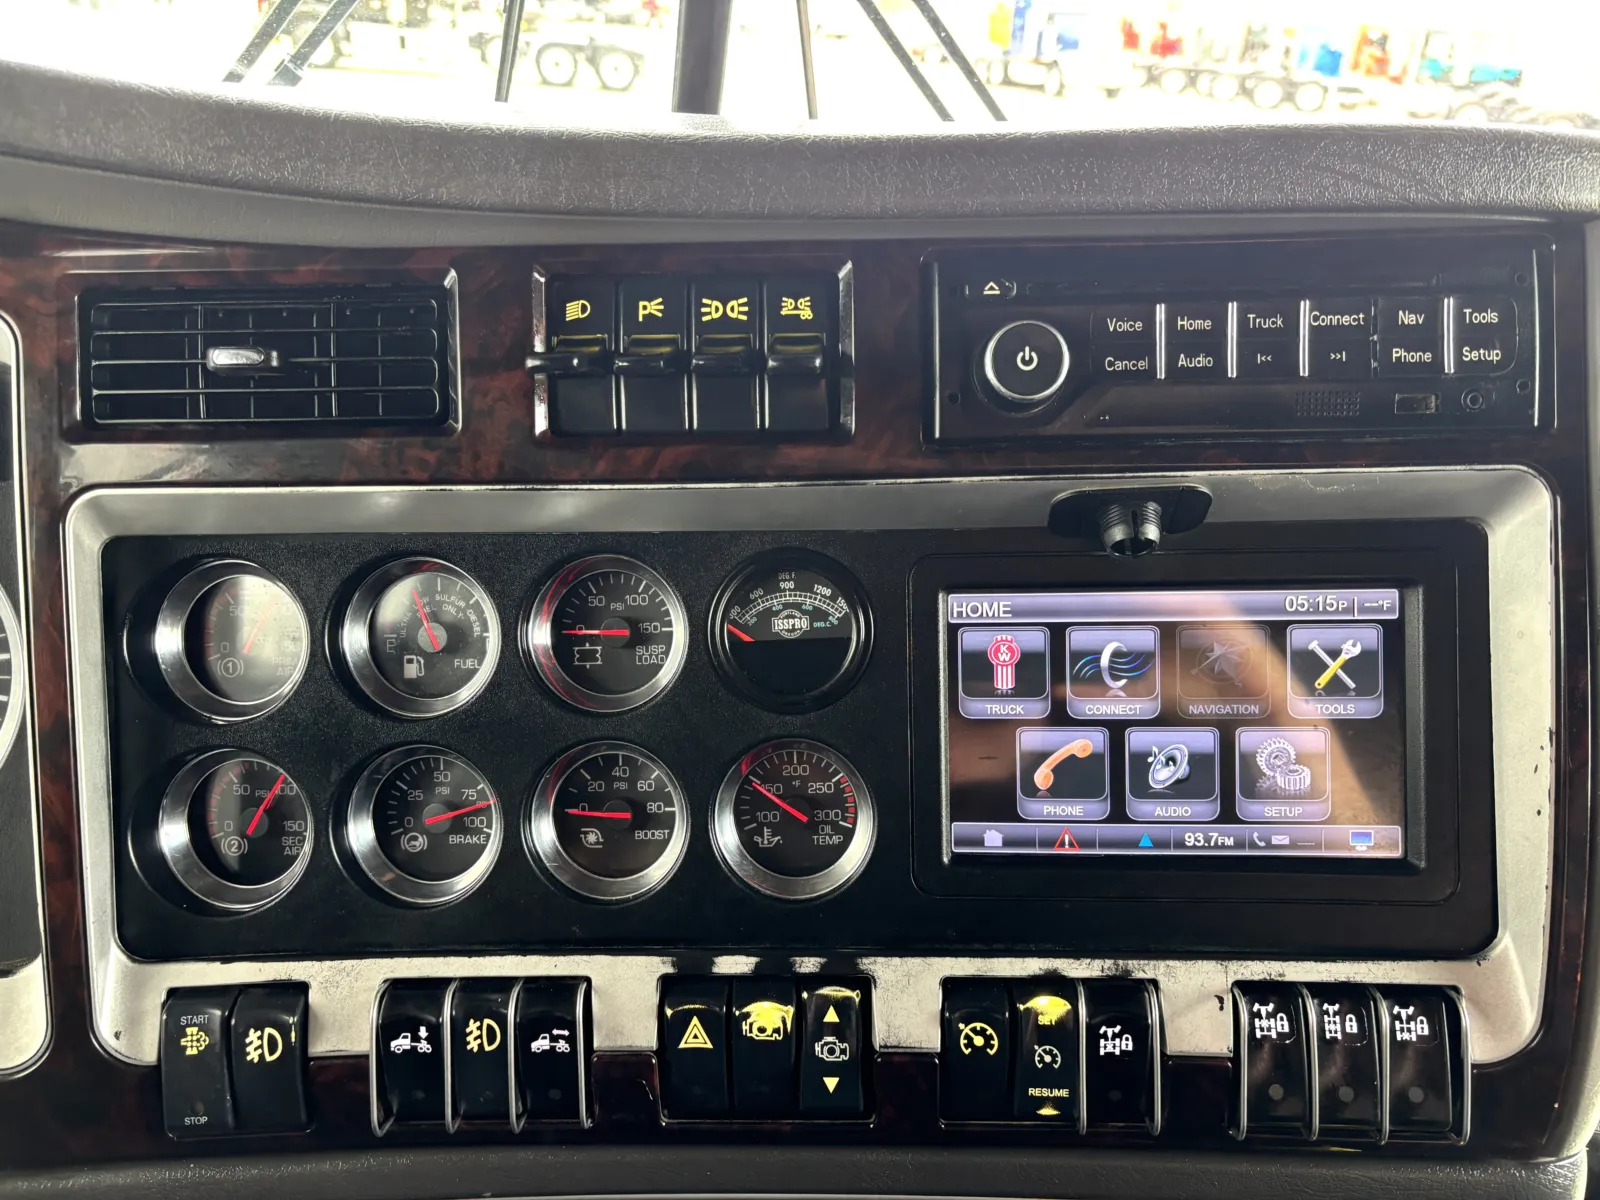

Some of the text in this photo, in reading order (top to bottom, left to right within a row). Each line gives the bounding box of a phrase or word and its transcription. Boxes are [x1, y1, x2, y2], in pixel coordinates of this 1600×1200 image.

[1247, 314, 1284, 329] Truck
[1310, 311, 1365, 327] Connect
[1398, 310, 1425, 325] Nav
[1463, 309, 1499, 324] Tools
[1106, 318, 1143, 332] Voice
[1177, 316, 1212, 331] Home
[1177, 353, 1213, 368] Audio
[1391, 348, 1432, 364] Phone
[1461, 347, 1502, 364] Setup
[1105, 356, 1149, 371] Cancel
[779, 580, 795, 590] 900
[813, 584, 832, 597] 1200
[749, 587, 764, 600] 600
[435, 593, 466, 609] SULFUR
[588, 595, 606, 607] 50
[624, 594, 649, 606] 100
[416, 604, 437, 619] FEL
[610, 603, 625, 611] PSI
[952, 601, 1013, 618] HOME
[399, 611, 413, 638] ULTRA
[466, 609, 481, 638] DIESEL
[638, 622, 661, 634] 150
[774, 618, 808, 630] ISSPRO
[220, 641, 230, 653] 0
[635, 645, 666, 655] SUSP
[454, 658, 481, 669] FUEL
[635, 655, 667, 665] LOAD
[985, 704, 1025, 715] TRUCK
[1084, 703, 1142, 716] CONNECT
[1188, 703, 1260, 715] NAVIGATION
[1315, 703, 1356, 715] TOOLS
[611, 766, 630, 778] 40
[782, 764, 810, 776] 200
[433, 771, 451, 782] 50
[233, 784, 250, 795] 50
[275, 784, 297, 795] 00
[435, 787, 450, 795] PSI
[587, 780, 605, 792] 20
[613, 782, 628, 790] PSI
[637, 780, 655, 791] 60
[808, 782, 834, 793] 250
[407, 789, 424, 801] 25
[461, 789, 477, 800] 75
[646, 802, 664, 813] 80
[1043, 805, 1084, 816] PHONE
[1154, 806, 1192, 817] AUDIO
[1263, 806, 1303, 817] SETUP
[755, 811, 780, 822] 100
[814, 809, 842, 821] 300
[224, 820, 234, 832] 0
[283, 820, 305, 832] 150
[404, 816, 414, 828] 0
[462, 816, 487, 828] 100
[634, 830, 670, 840] BOOST
[818, 824, 835, 834] OIL
[281, 836, 304, 846] SEC
[448, 834, 488, 845] BRAKE
[812, 835, 844, 845] TEMP
[284, 847, 302, 856] AIR
[180, 1014, 209, 1026] START
[1028, 1087, 1070, 1098] RESUME
[183, 1115, 208, 1126] STOP
